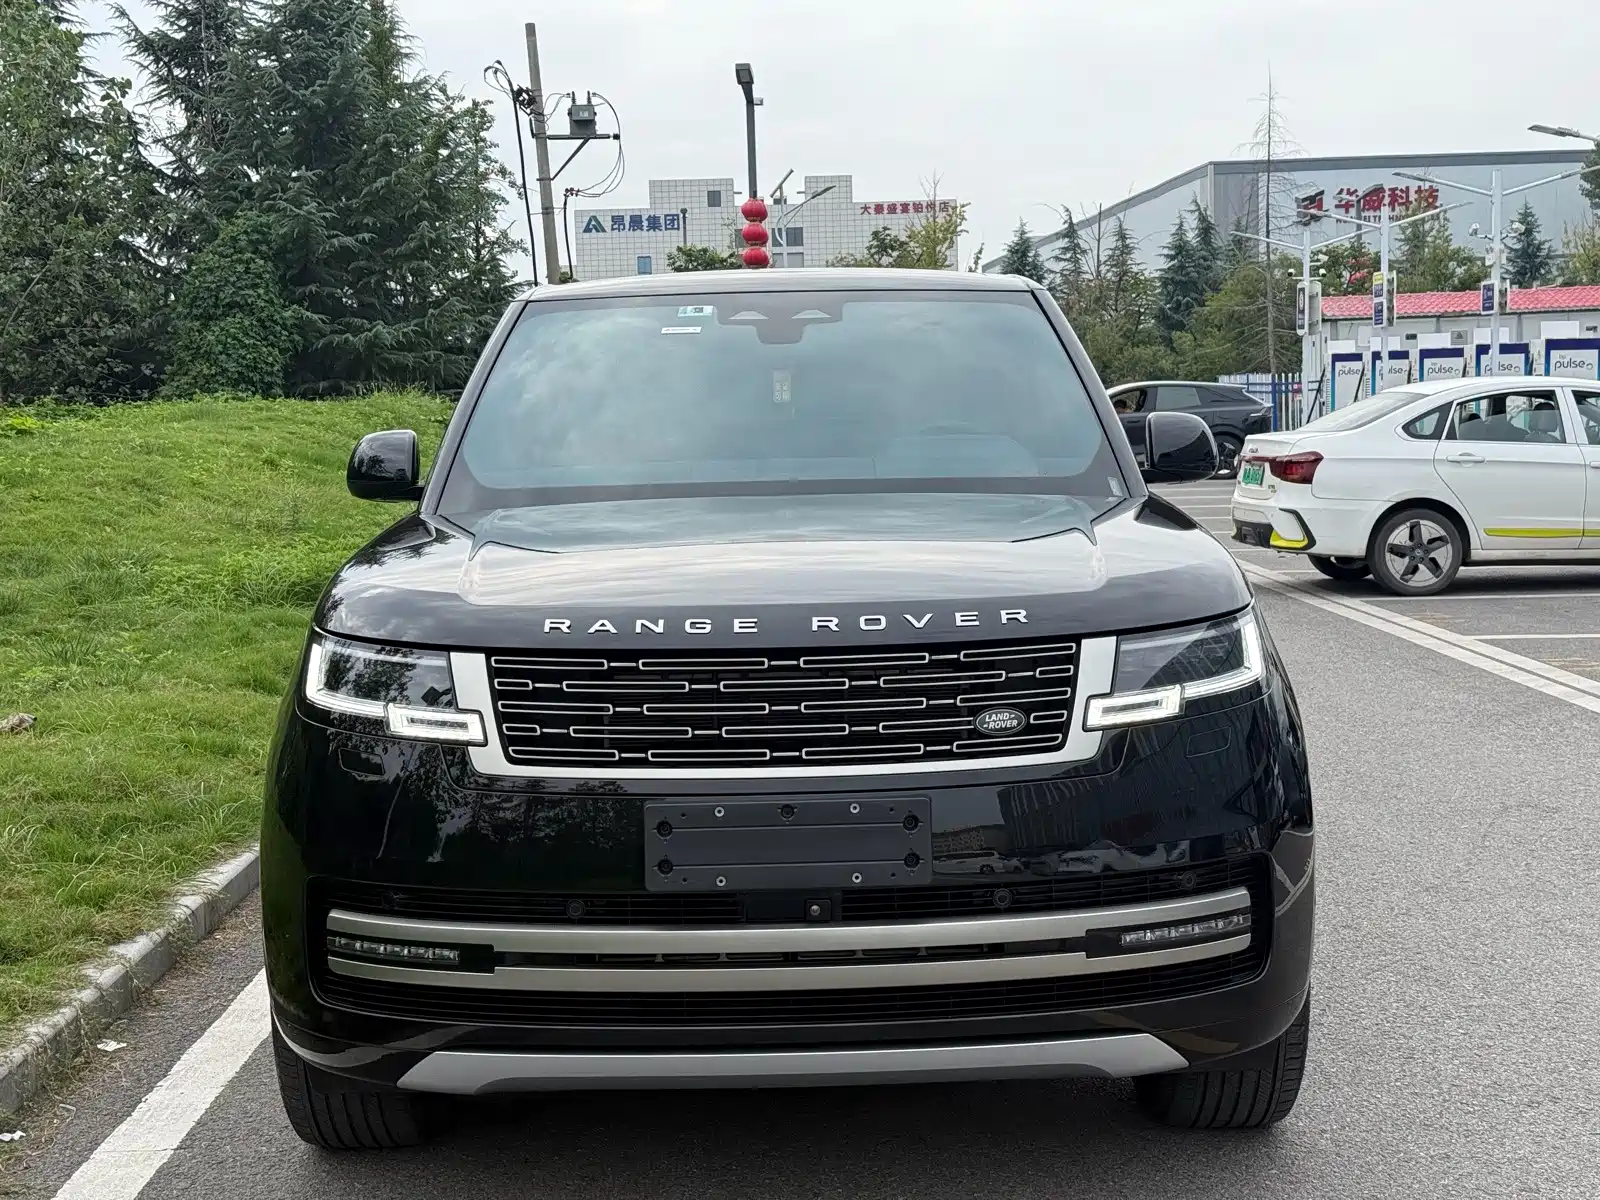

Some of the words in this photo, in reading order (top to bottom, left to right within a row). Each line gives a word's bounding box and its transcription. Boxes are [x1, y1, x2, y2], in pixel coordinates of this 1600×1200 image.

[611, 214, 680, 232] 昂晨集团
[1427, 364, 1454, 376] pulse
[1484, 360, 1513, 374] plse
[1554, 357, 1586, 371] pulse
[1338, 366, 1360, 377] pulse
[543, 618, 758, 634] RANGE
[811, 608, 1029, 632] ROVER
[985, 712, 1010, 722] LAND
[988, 719, 1018, 730] ROVER
